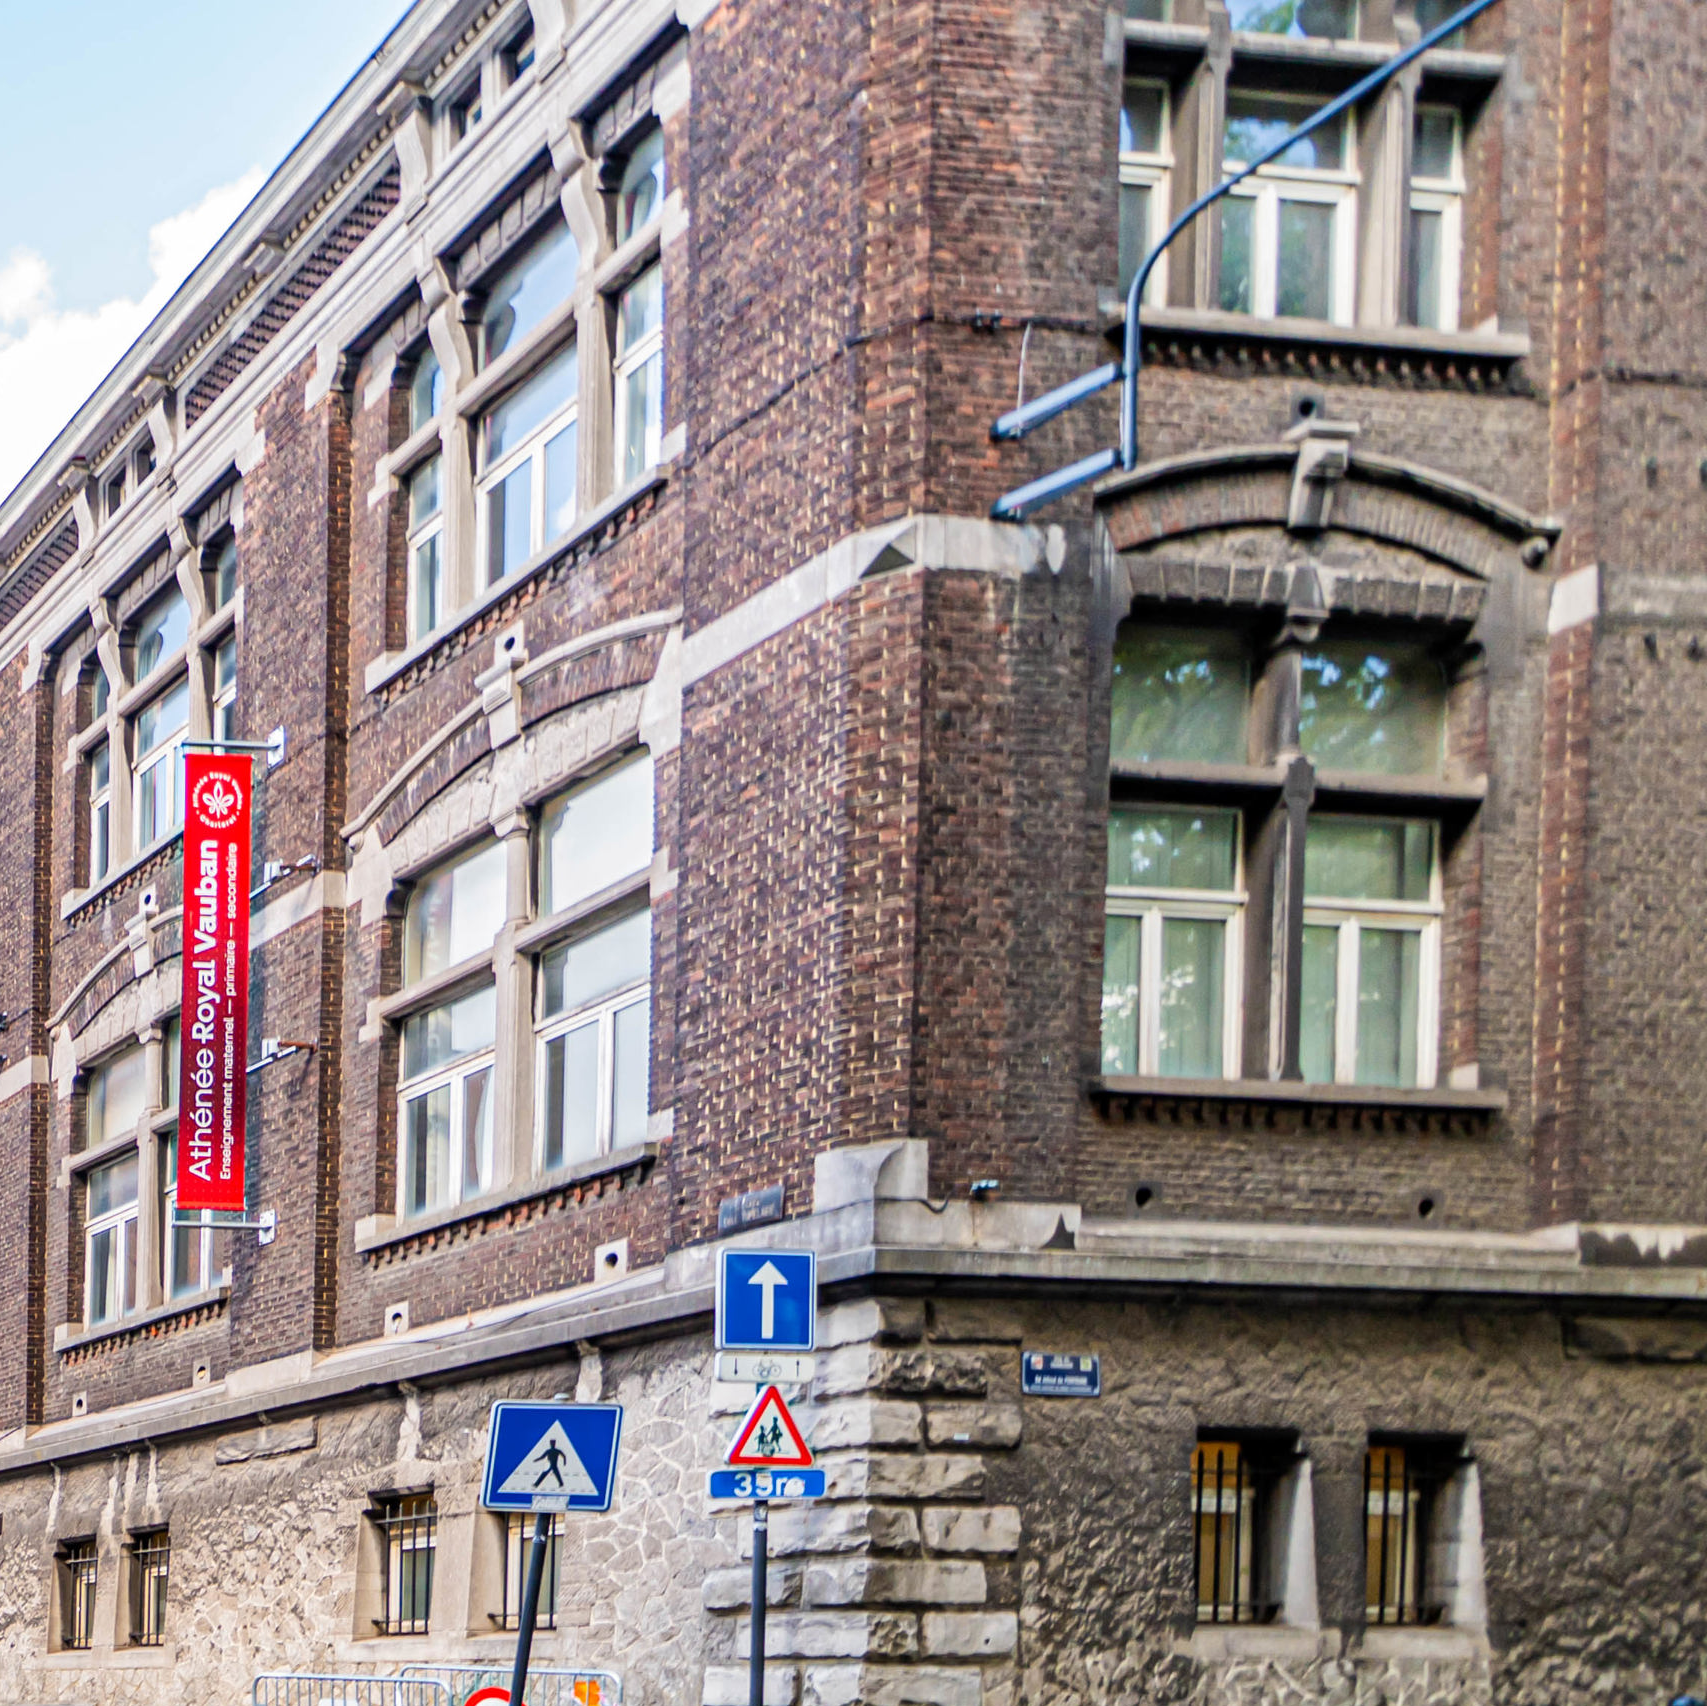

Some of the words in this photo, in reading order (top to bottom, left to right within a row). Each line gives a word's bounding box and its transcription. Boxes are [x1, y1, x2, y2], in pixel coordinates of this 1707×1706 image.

[193, 839, 219, 953] Vauban
[225, 842, 238, 919] secondaire
[191, 959, 221, 1044] Royal
[224, 939, 237, 997] primaire
[223, 1016, 235, 1080] maternel
[188, 1048, 214, 1181] Athénée
[219, 1081, 235, 1180] Enseignement
